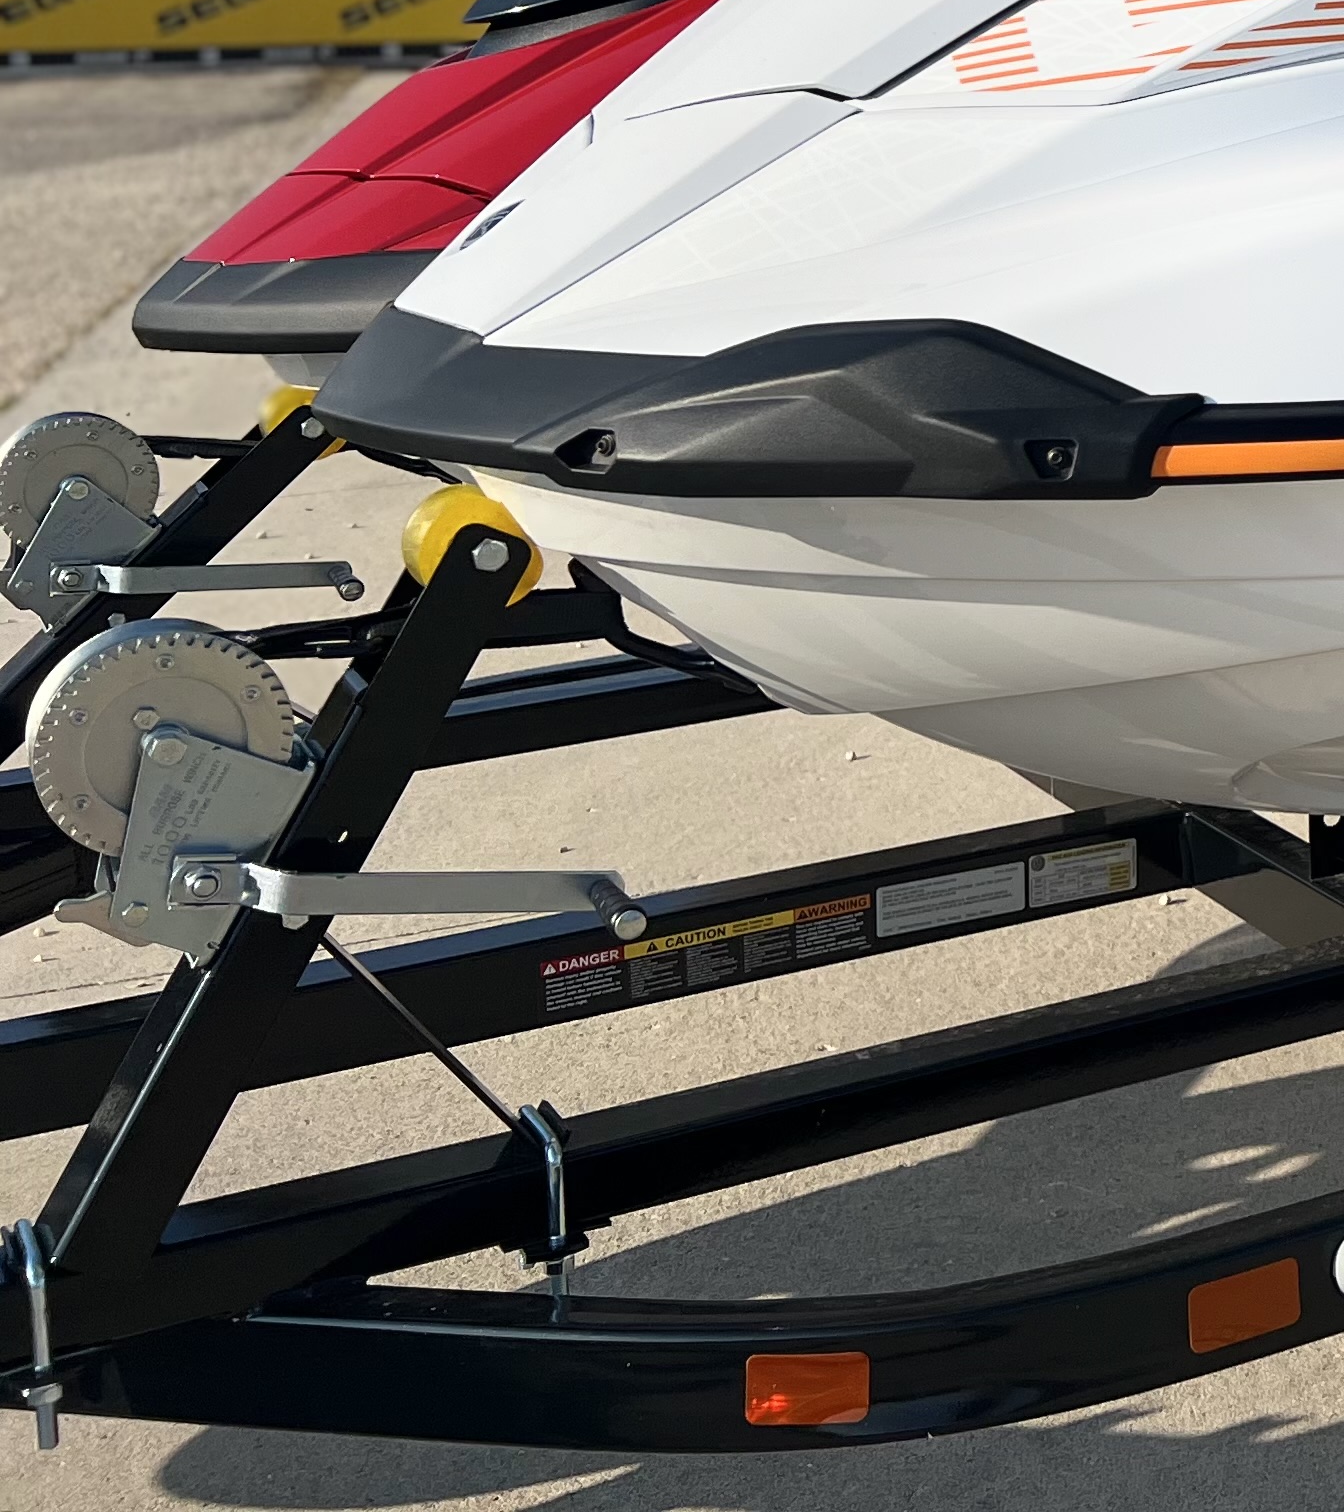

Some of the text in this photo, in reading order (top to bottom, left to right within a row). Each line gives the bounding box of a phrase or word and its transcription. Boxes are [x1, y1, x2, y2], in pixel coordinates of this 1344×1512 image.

[808, 897, 868, 918] WARNING
[665, 926, 727, 948] CAUTION
[559, 949, 620, 972] DANGER
